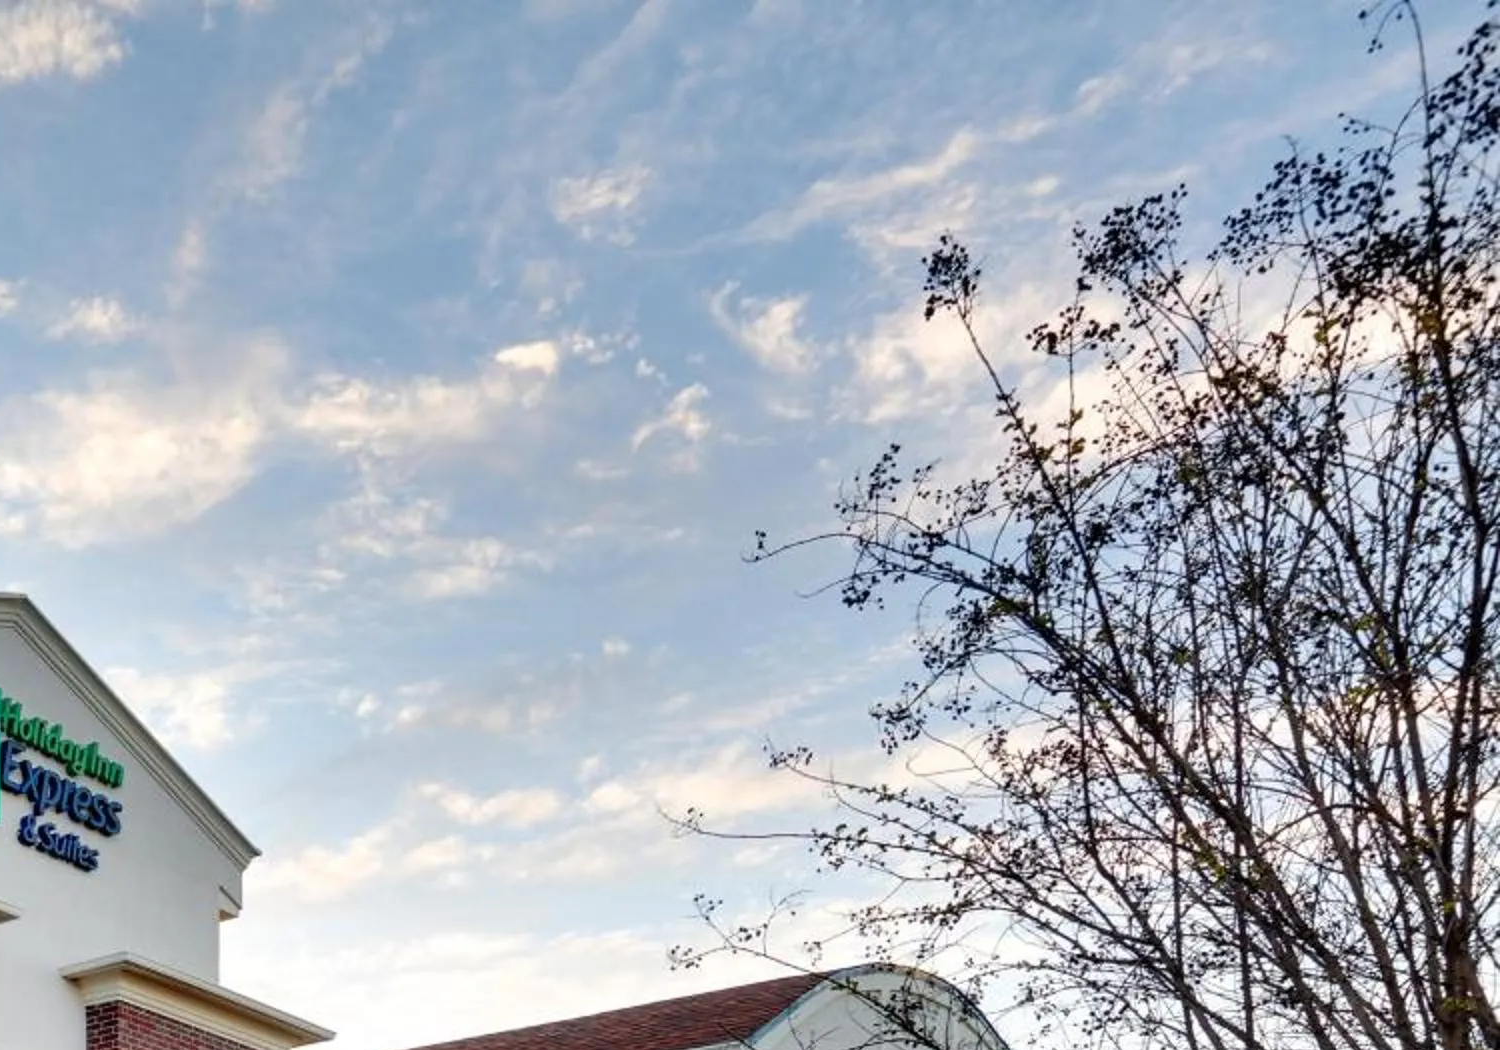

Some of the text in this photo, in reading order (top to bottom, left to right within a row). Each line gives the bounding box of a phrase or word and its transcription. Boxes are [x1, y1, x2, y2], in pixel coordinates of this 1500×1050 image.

[0, 697, 125, 788] Holiday Inn
[0, 739, 123, 837] Express
[17, 813, 99, 872] & Suites
